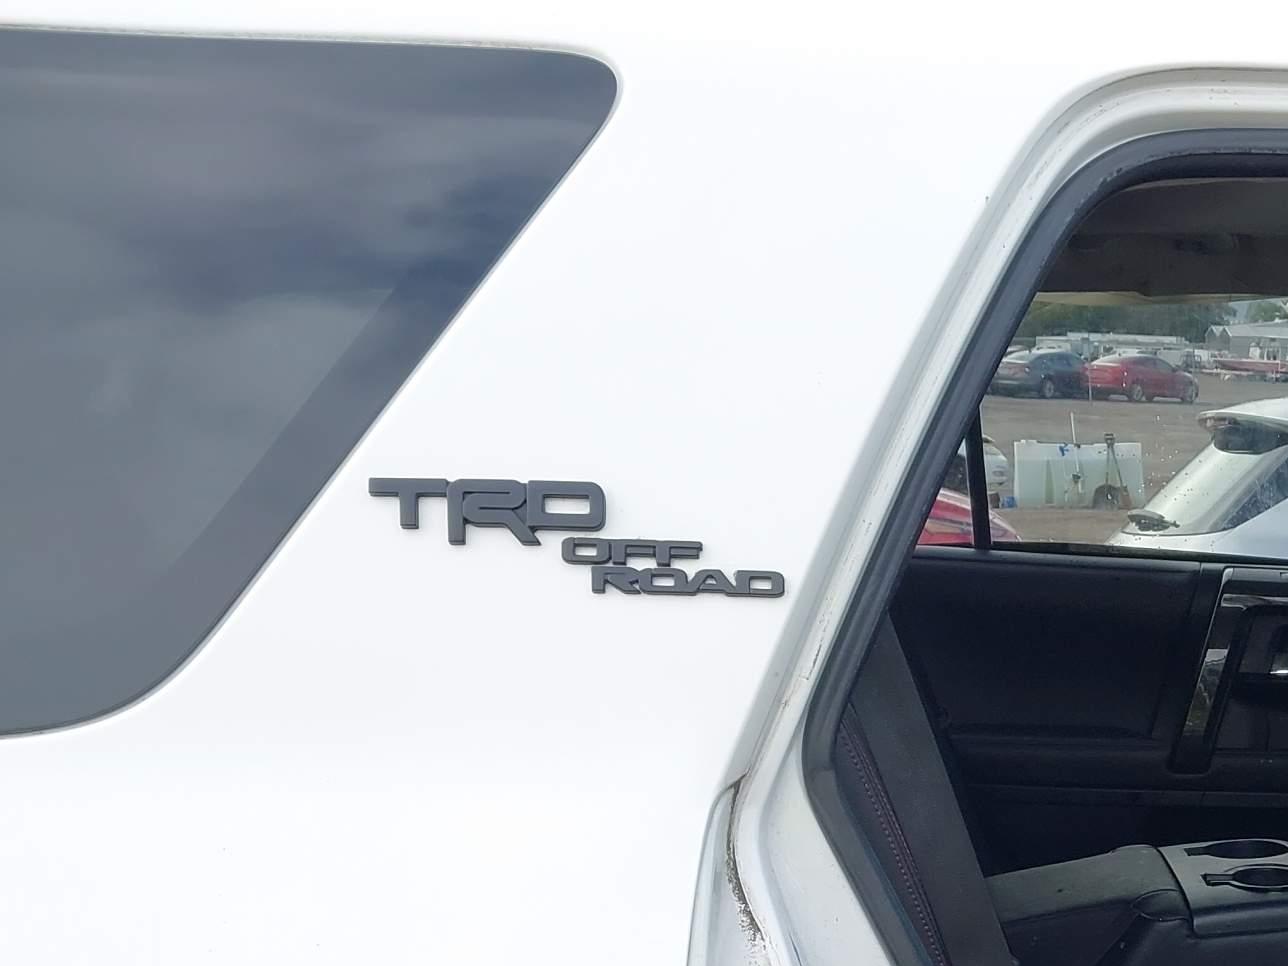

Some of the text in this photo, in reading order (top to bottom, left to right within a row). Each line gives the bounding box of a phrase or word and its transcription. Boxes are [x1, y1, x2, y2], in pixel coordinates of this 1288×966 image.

[368, 477, 606, 546] TRD
[561, 536, 703, 567] OFF
[591, 565, 785, 598] ROAD
